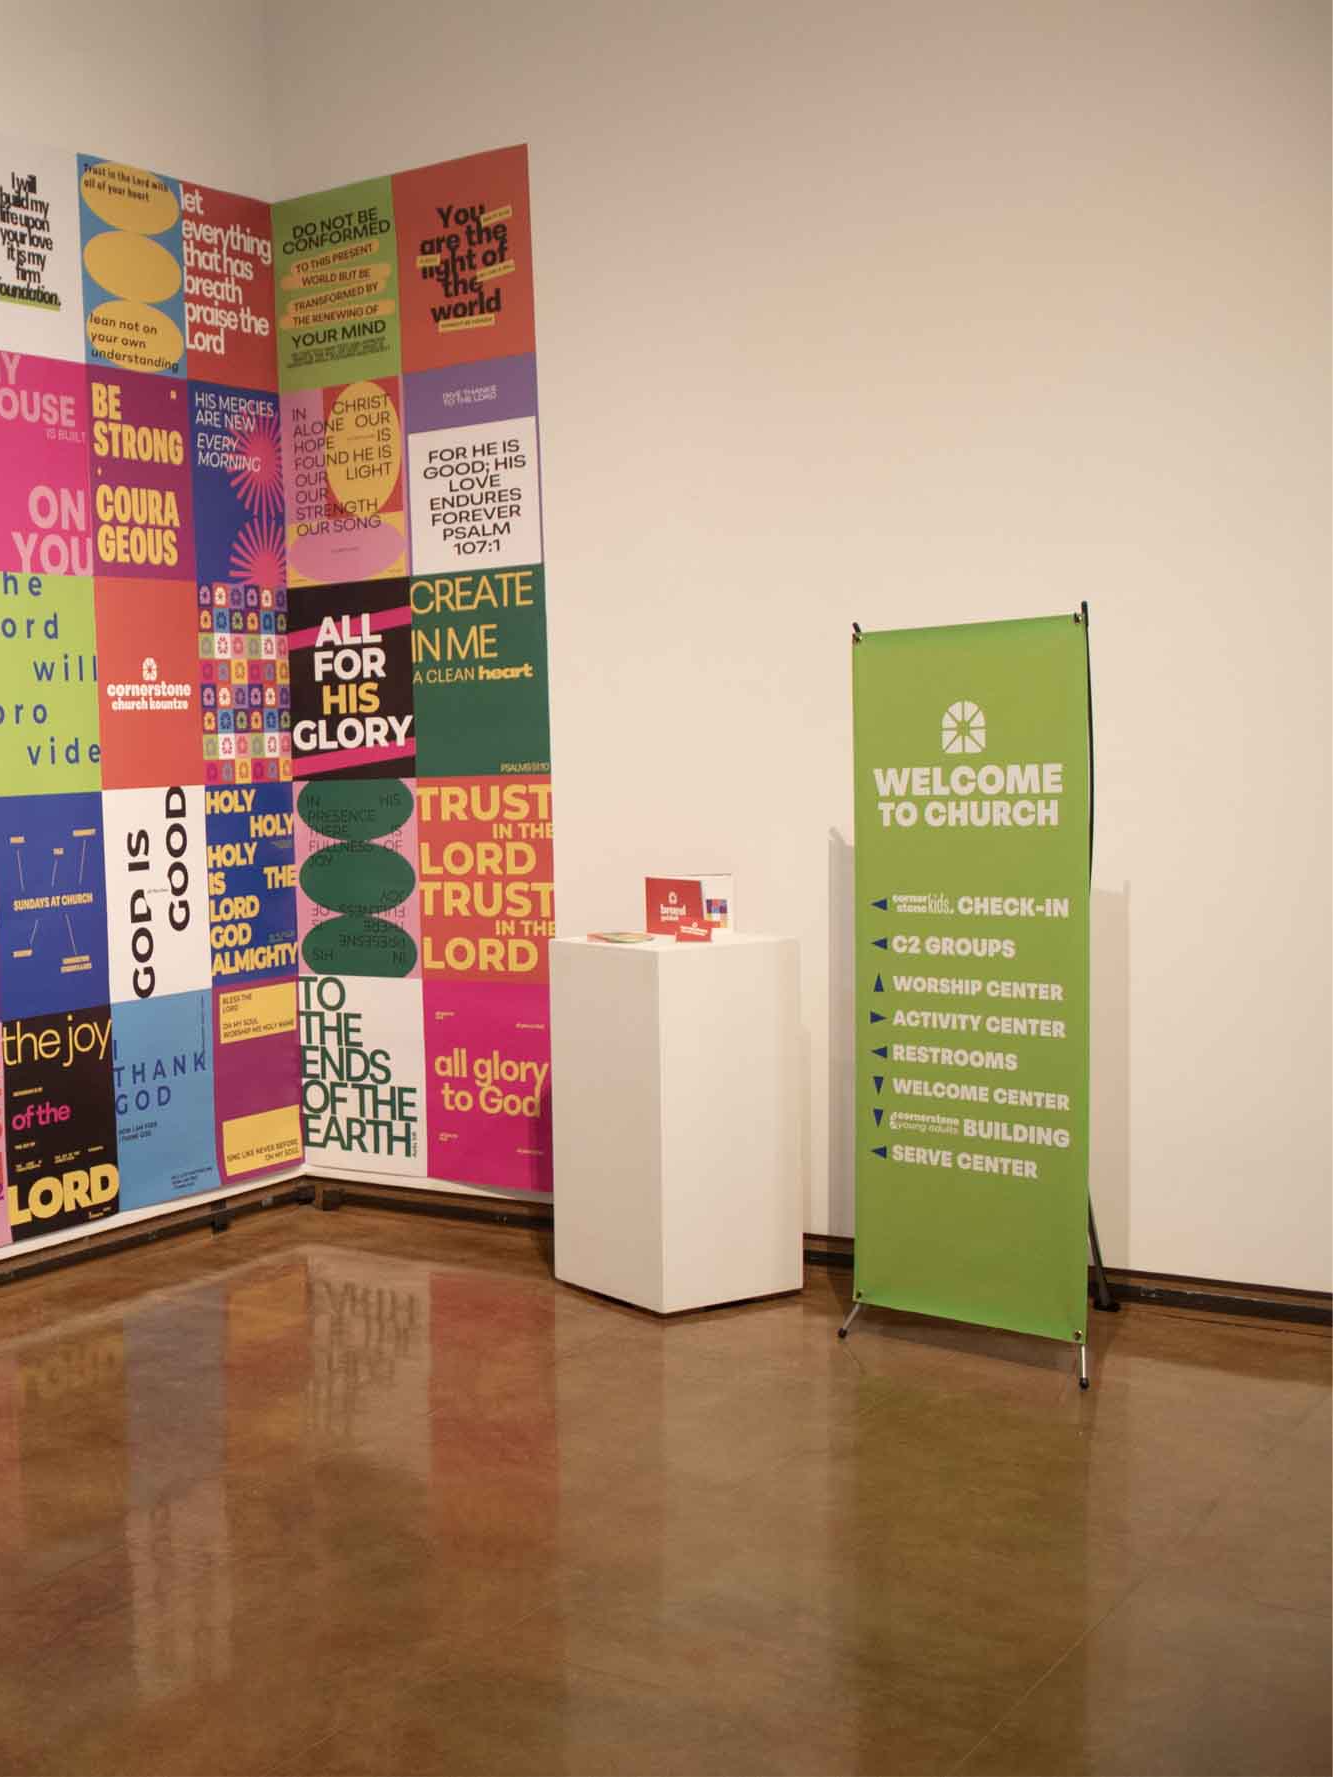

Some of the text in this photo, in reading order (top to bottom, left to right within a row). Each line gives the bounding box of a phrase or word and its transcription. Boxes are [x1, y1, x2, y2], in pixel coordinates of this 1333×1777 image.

[283, 219, 390, 255] CONFORMED
[293, 208, 378, 239] DO NOT BE
[182, 220, 271, 264] everything
[184, 265, 242, 305] breath
[90, 314, 157, 335] lean not on
[186, 322, 225, 355] Lord
[292, 320, 386, 349] YOUR MIND
[91, 349, 179, 373] understanding
[92, 382, 122, 420] BE
[195, 391, 274, 417] HIS MERCIES
[292, 393, 389, 421] IN CHRIST
[195, 410, 256, 432] ARE NEW
[293, 412, 391, 438] ALONE OUR
[94, 420, 184, 465] STRONG
[197, 433, 239, 452] EVERY
[294, 436, 335, 456] HOPE
[429, 439, 520, 463] FOR HE IS
[198, 452, 261, 472] MORNING
[294, 448, 374, 471] FOUND HE
[423, 454, 526, 480] GOOD; HIS
[295, 463, 392, 487] OUR LIGHT
[449, 473, 500, 493] LOVE
[28, 485, 85, 531] ON
[96, 484, 180, 528] COURA
[296, 488, 328, 504] OUR
[297, 499, 379, 521] STRENGTH
[430, 487, 522, 511] ENDURES
[297, 514, 381, 537] OUR SONG
[431, 504, 521, 527] FOREVER
[97, 524, 178, 566] GEOUS
[443, 521, 511, 541] PSALM
[11, 531, 93, 576] YOU
[454, 539, 501, 556] 107:1
[410, 570, 534, 615] CREATE
[315, 612, 382, 647] ALL
[411, 623, 498, 664] IN ME
[33, 654, 98, 682] will
[314, 647, 386, 682] FOR
[413, 663, 534, 685] A CLEAN heart
[107, 681, 191, 697] cornerstone
[322, 682, 380, 715] HIS
[111, 698, 148, 711] church
[292, 715, 414, 751] GLORY
[26, 737, 101, 765] vide
[873, 763, 1063, 797] WELCOME
[205, 789, 256, 814] HOLY
[417, 784, 551, 821] TRUST
[878, 800, 1058, 826] TO CHURCH
[250, 813, 294, 838] HOLY
[492, 823, 554, 839] IN THE
[164, 786, 190, 931] GOOD
[207, 842, 257, 869] HOLY
[420, 841, 536, 875] LORD
[208, 865, 298, 896] IS THE
[13, 892, 93, 911] SUNDAYS AT CHURCH
[210, 895, 260, 922] LORD
[660, 904, 686, 916] brand
[958, 896, 1068, 917] CHECK-IN
[130, 889, 156, 999] GOD
[210, 923, 252, 950] GOD
[892, 936, 1015, 959] C2 GROUPS
[211, 942, 298, 976] ALMIGHTY
[299, 976, 346, 1011] TO
[893, 975, 1063, 1000] WORSHIP CENTER
[299, 1011, 363, 1047] THE
[893, 1010, 1066, 1037] ACTIVITY CENTER
[2, 1014, 112, 1067] the joy
[114, 1053, 206, 1088] THANK
[301, 1045, 391, 1084] ENDS
[435, 1047, 548, 1097] all glory
[893, 1045, 1018, 1071] RESTROOMS
[115, 1086, 171, 1115] GOD
[302, 1079, 417, 1122] OF THE
[441, 1082, 473, 1112] to
[893, 1078, 1069, 1110] WELCOME CENTER
[36, 1101, 71, 1126] the
[302, 1114, 411, 1157] EARTH
[964, 1119, 1069, 1147] BUILDING
[892, 1144, 1037, 1178] SERVE CENTER
[7, 1163, 120, 1226] LORD
